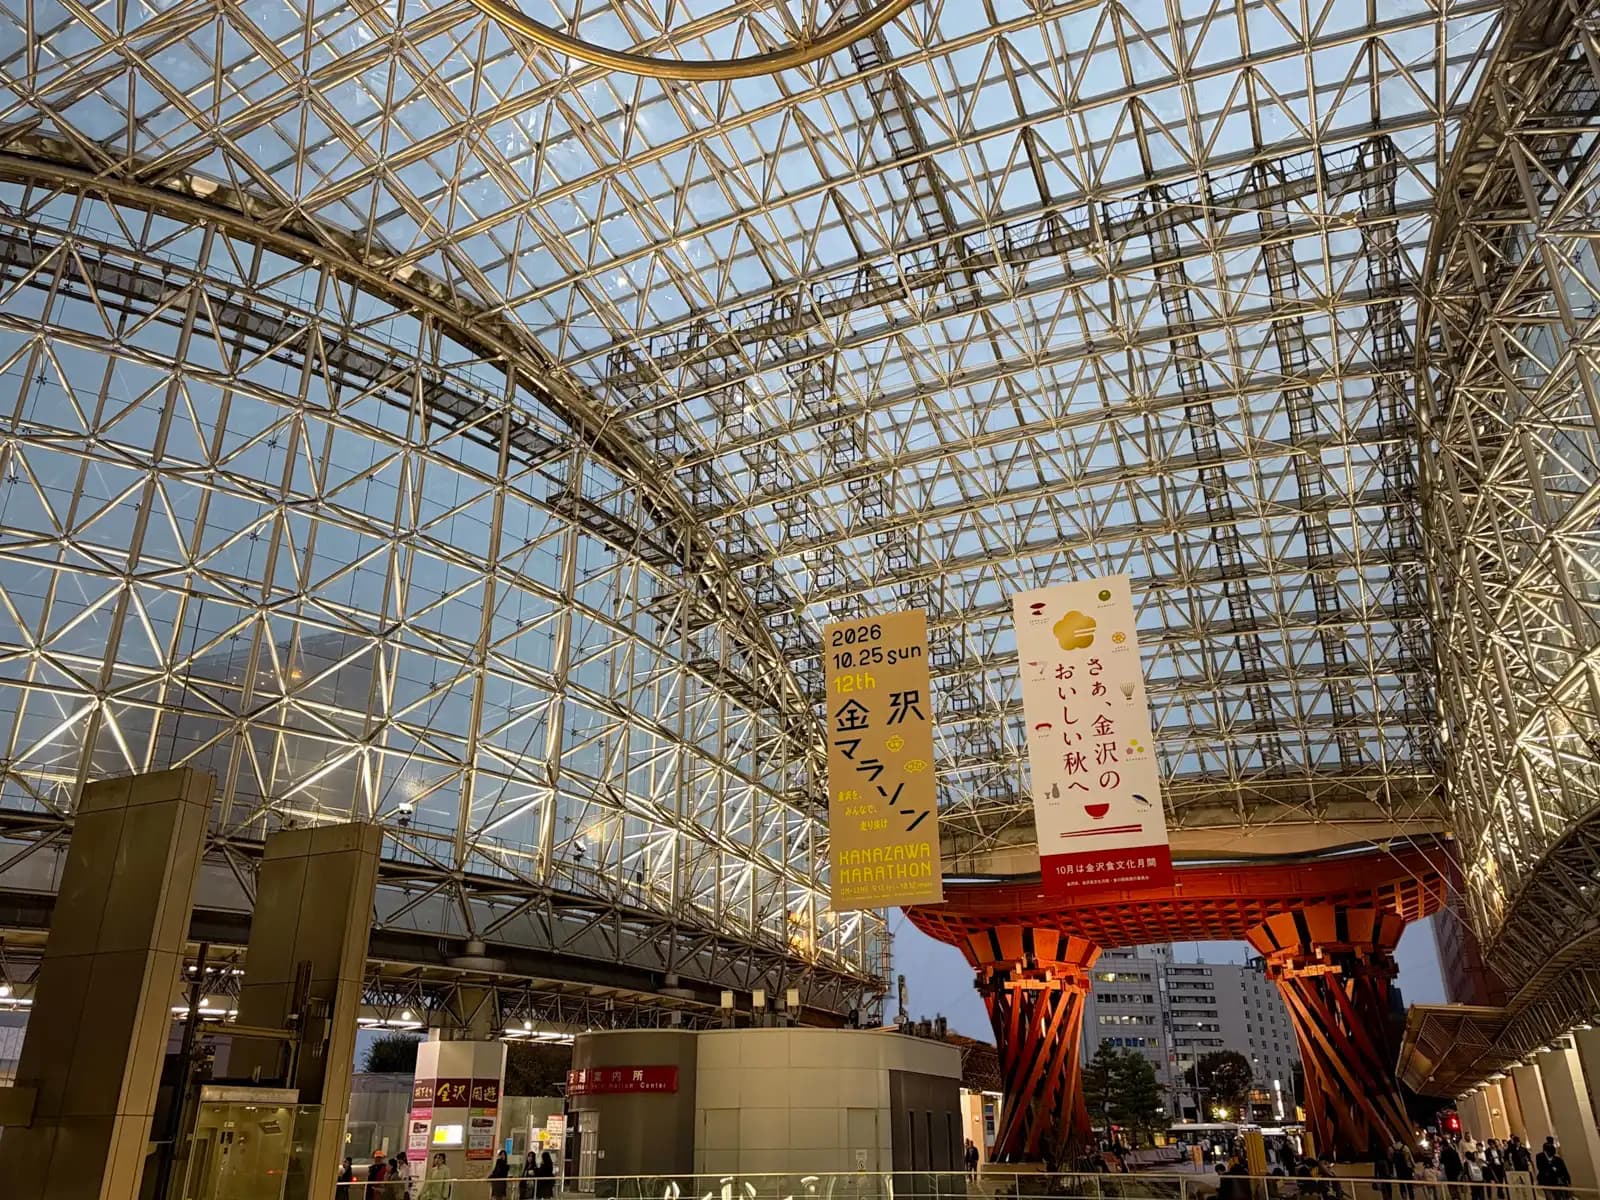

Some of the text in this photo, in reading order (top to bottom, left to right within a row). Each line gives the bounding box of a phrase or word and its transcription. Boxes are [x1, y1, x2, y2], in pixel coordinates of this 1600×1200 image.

[832, 624, 882, 647] 2026
[833, 645, 922, 670] 10.25 sun
[833, 672, 877, 694] 12th
[1055, 663, 1090, 791] おいしい秋へ
[839, 842, 931, 866] KANAZAWA
[839, 861, 932, 884] MARATHON
[1056, 857, 1157, 875] 10月は金沢食文化月間
[437, 1083, 466, 1102] 金沢
